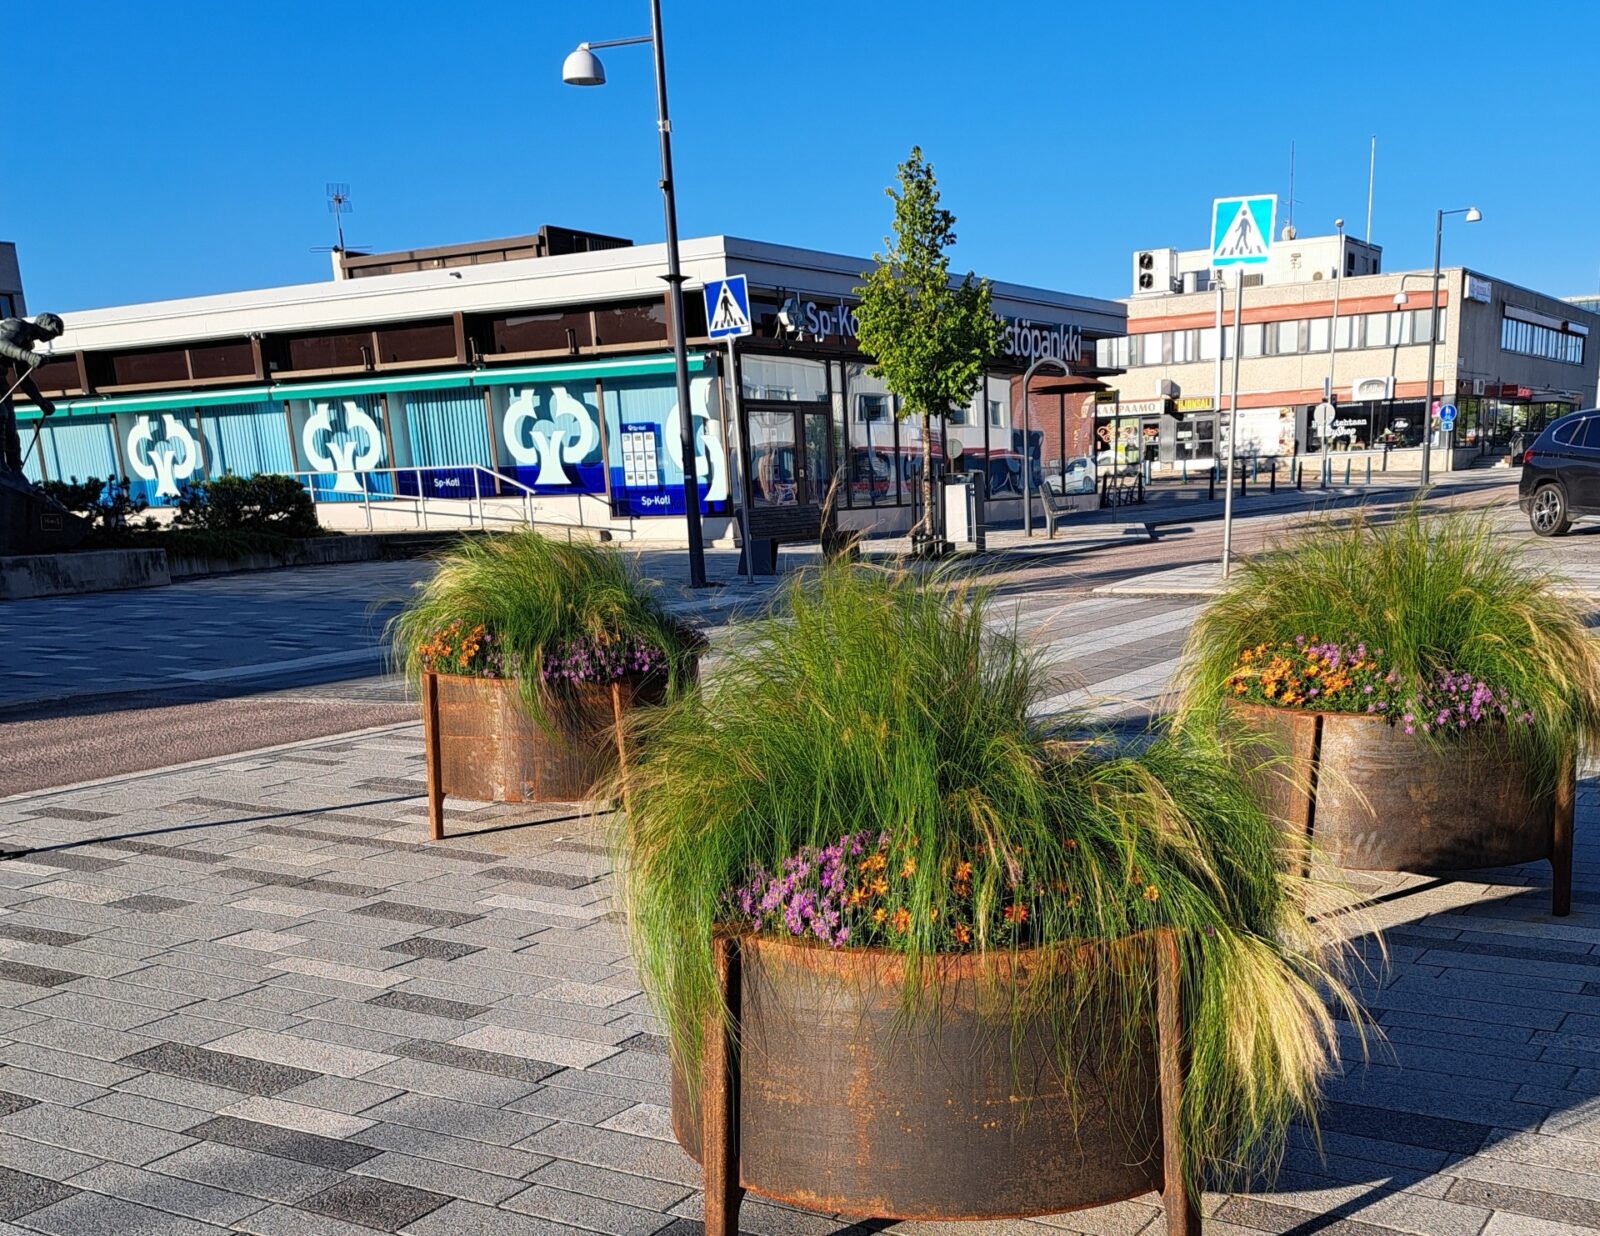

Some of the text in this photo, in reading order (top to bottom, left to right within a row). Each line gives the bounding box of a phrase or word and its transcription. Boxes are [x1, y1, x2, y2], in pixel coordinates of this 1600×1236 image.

[806, 301, 861, 340] Sp-Ko
[433, 477, 461, 489] Sp-Koti
[641, 494, 671, 507] Sp-Koti
